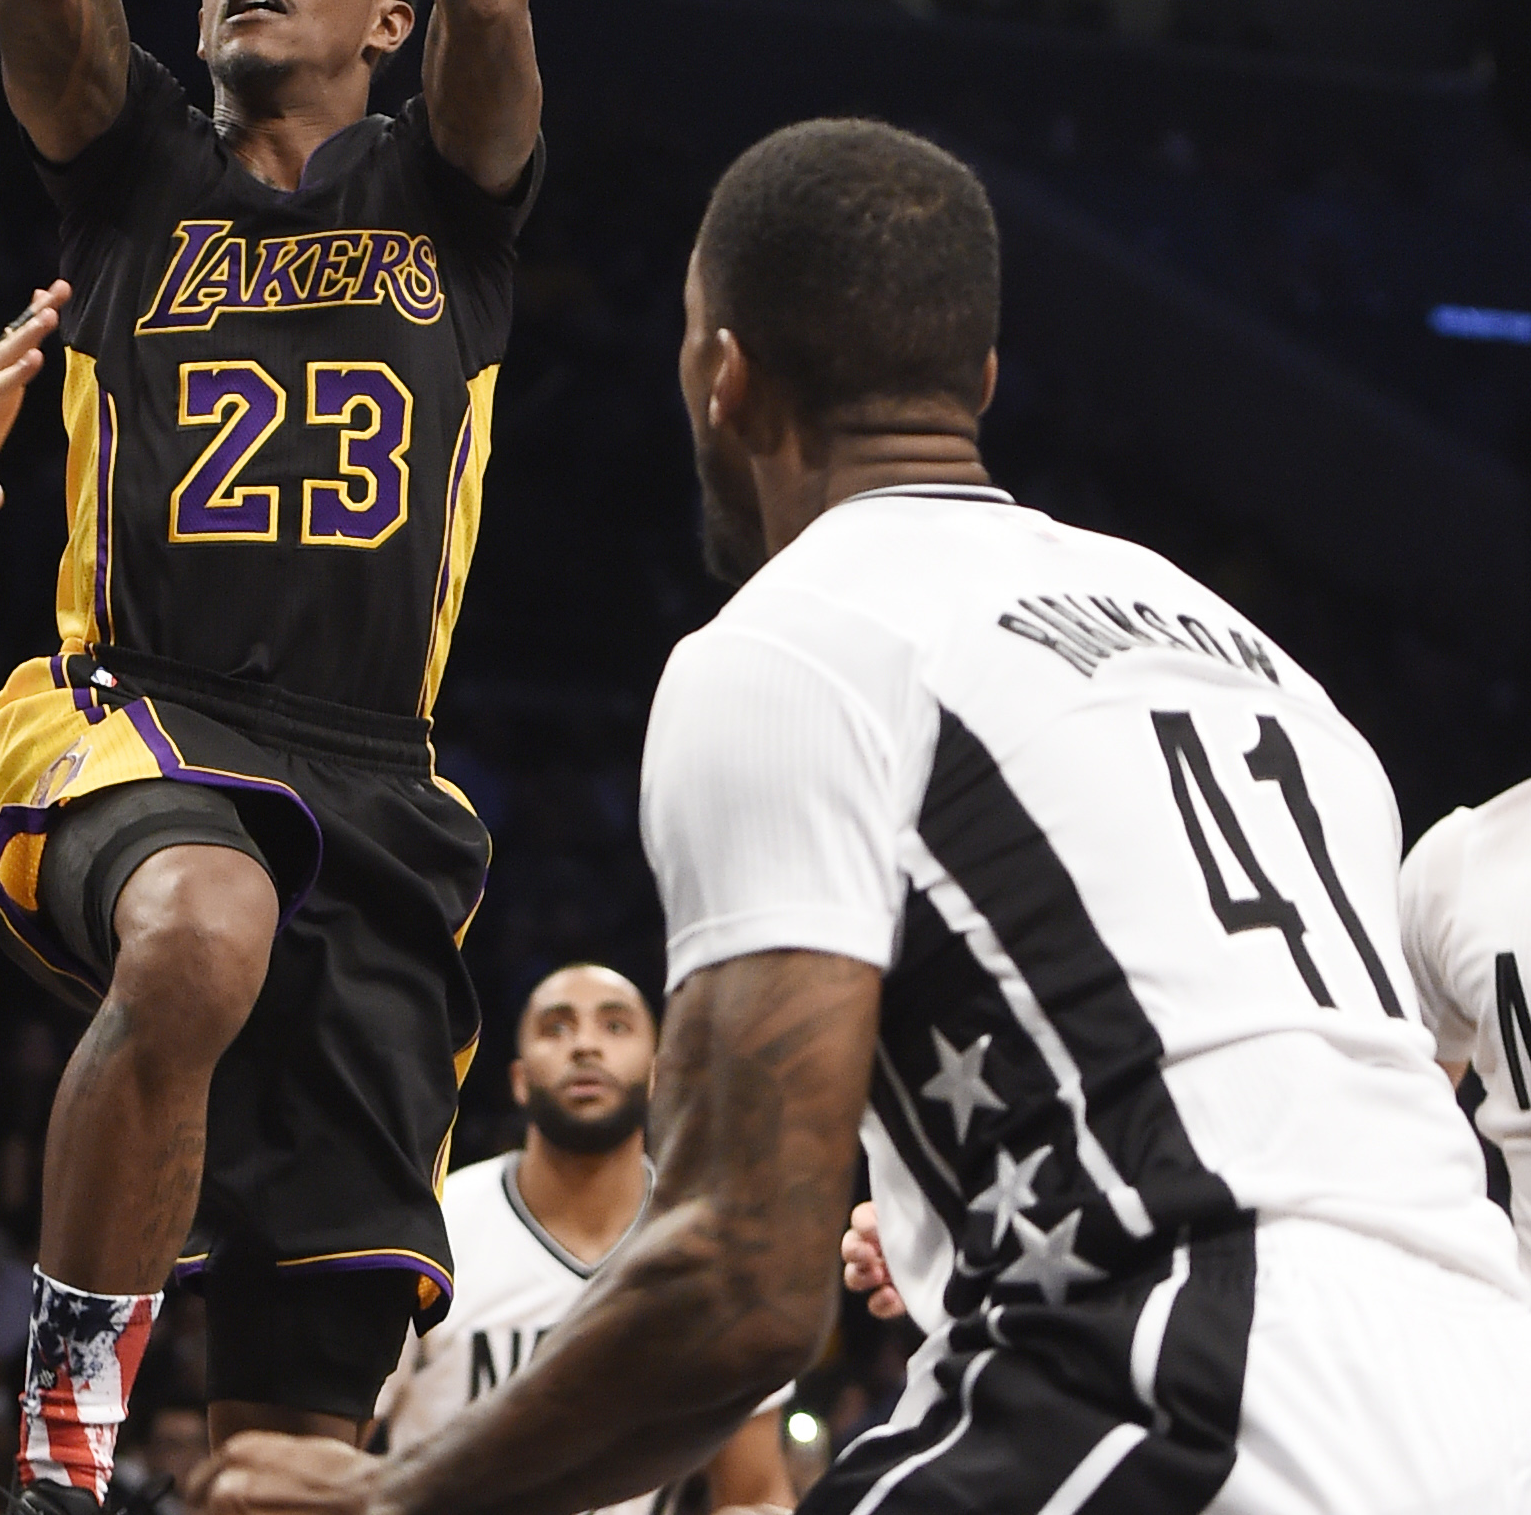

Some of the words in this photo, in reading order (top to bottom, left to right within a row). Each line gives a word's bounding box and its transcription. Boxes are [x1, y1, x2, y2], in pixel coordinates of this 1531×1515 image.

[135, 220, 445, 336] LAKERS
[169, 360, 413, 549] 23
[1150, 709, 1406, 1021] 41
